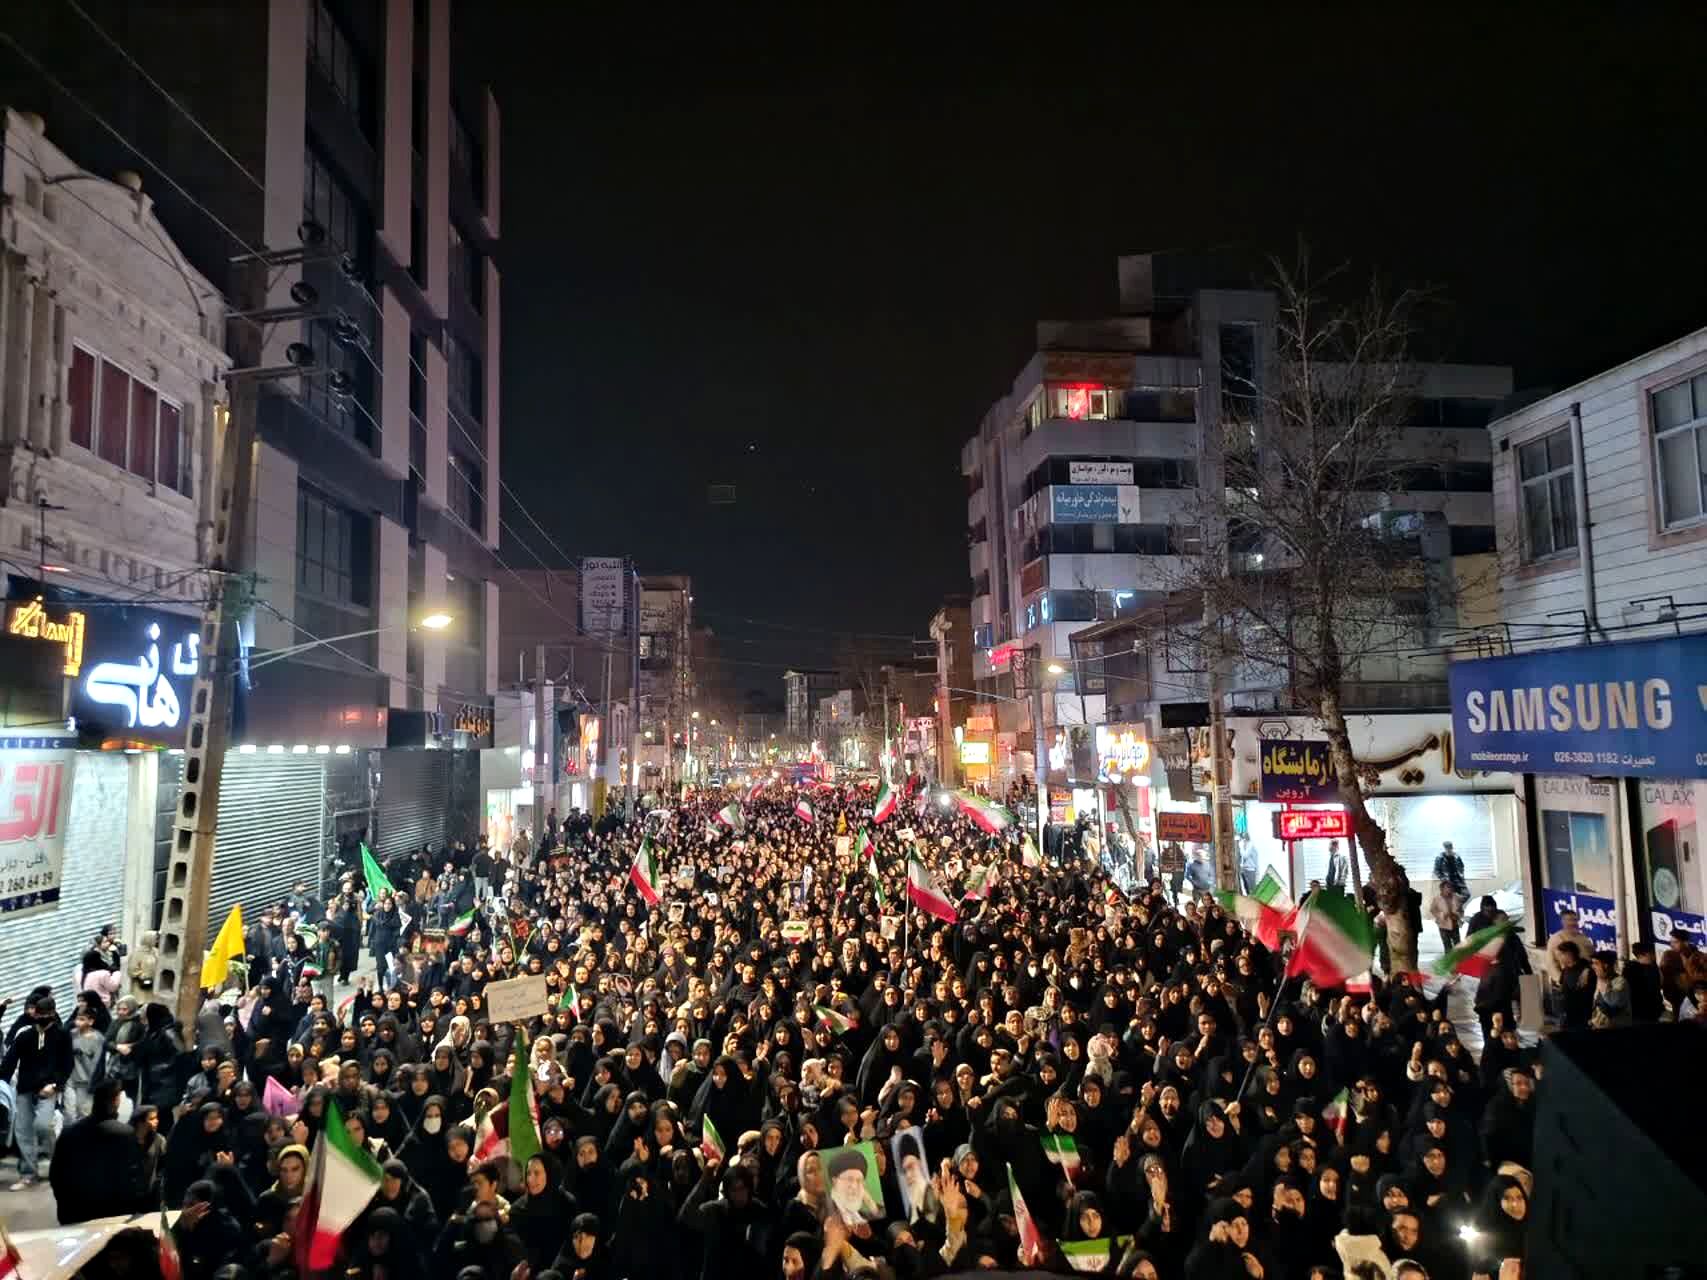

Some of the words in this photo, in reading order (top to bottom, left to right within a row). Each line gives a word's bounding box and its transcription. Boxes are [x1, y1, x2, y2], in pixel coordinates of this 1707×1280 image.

[1466, 677, 1673, 734] SAMSUNG
[1584, 782, 1610, 797] Note
[1644, 788, 1695, 806] GALAX
[1288, 816, 1312, 833] طلاق
[1313, 816, 1340, 832] دفتر
[1554, 895, 1616, 930] عمیرات
